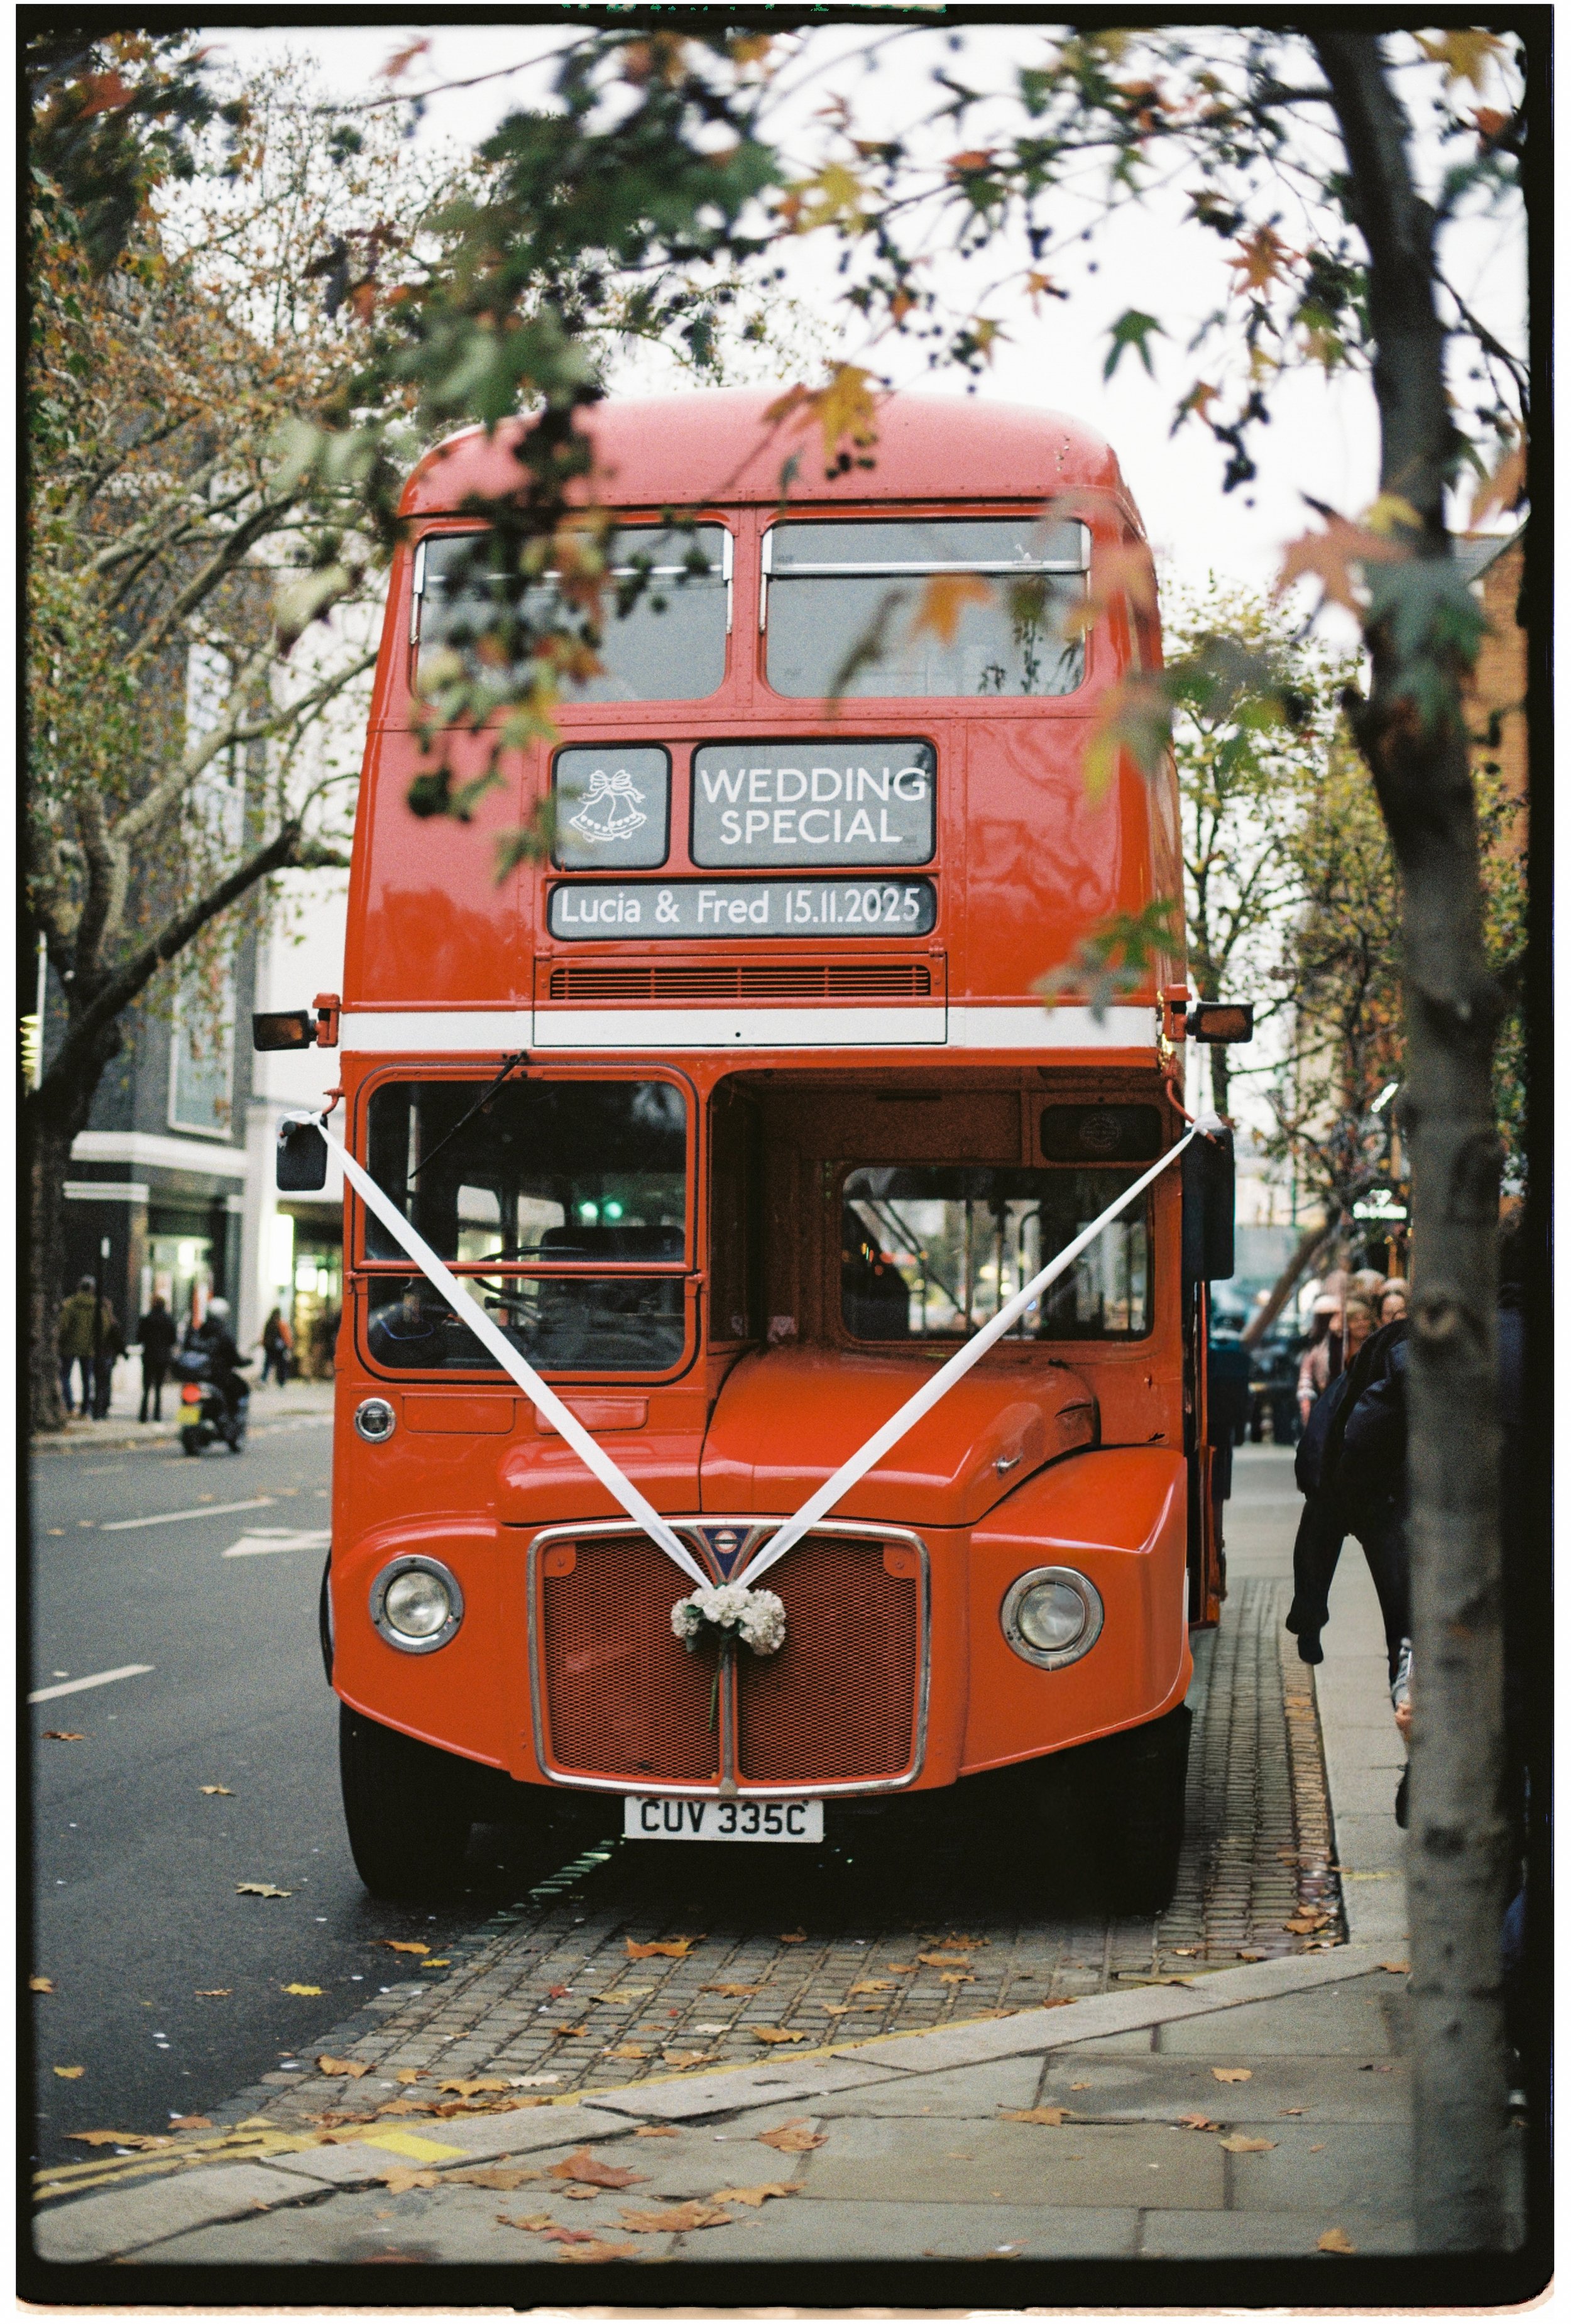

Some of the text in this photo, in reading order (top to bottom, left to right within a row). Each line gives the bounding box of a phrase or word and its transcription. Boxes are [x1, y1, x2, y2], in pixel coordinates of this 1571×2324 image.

[700, 767, 926, 803] WEDDING
[720, 808, 902, 845] SPECIAL
[561, 888, 919, 924] Lucia & Fred 15.11.2025
[640, 1800, 806, 1835] CUV 335C
